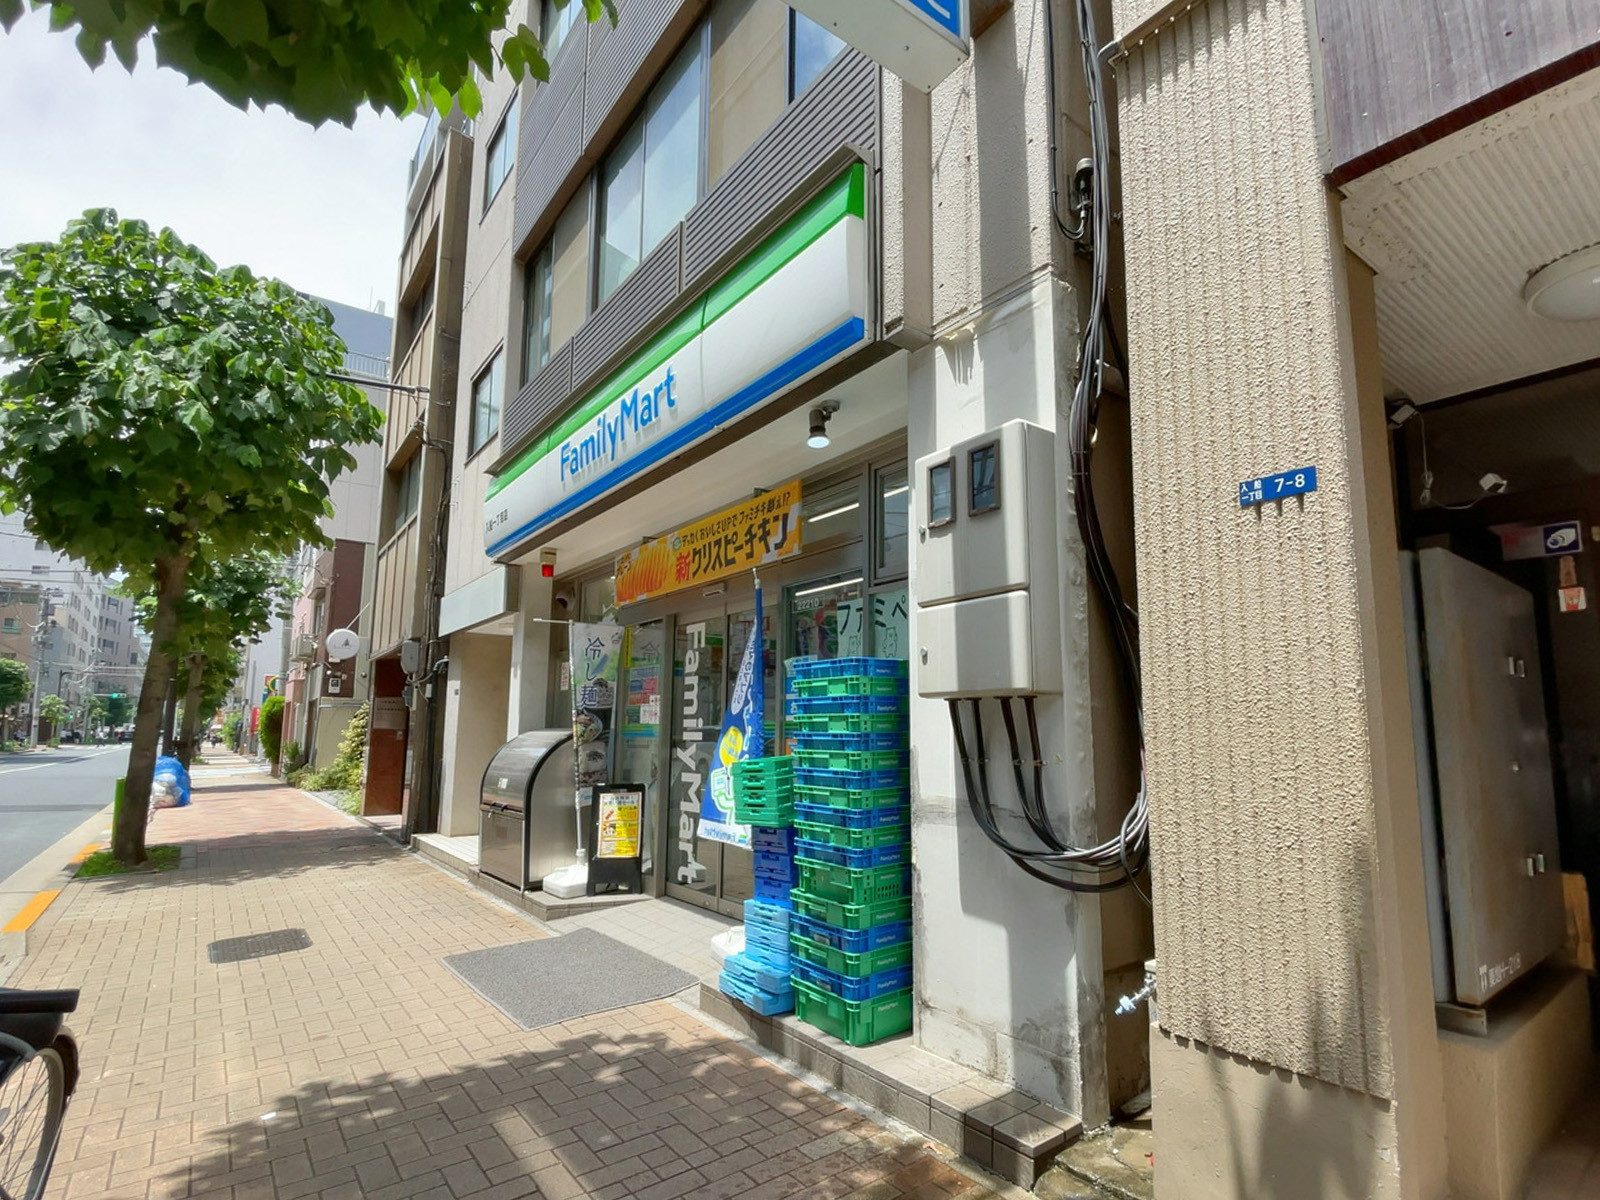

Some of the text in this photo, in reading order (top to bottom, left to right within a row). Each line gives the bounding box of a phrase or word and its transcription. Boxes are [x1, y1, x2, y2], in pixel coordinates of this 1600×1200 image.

[560, 366, 677, 481] FamilyMart
[1274, 473, 1306, 493] 7-8
[580, 636, 605, 708] 冷し麺
[677, 622, 706, 884] FamilyMart
